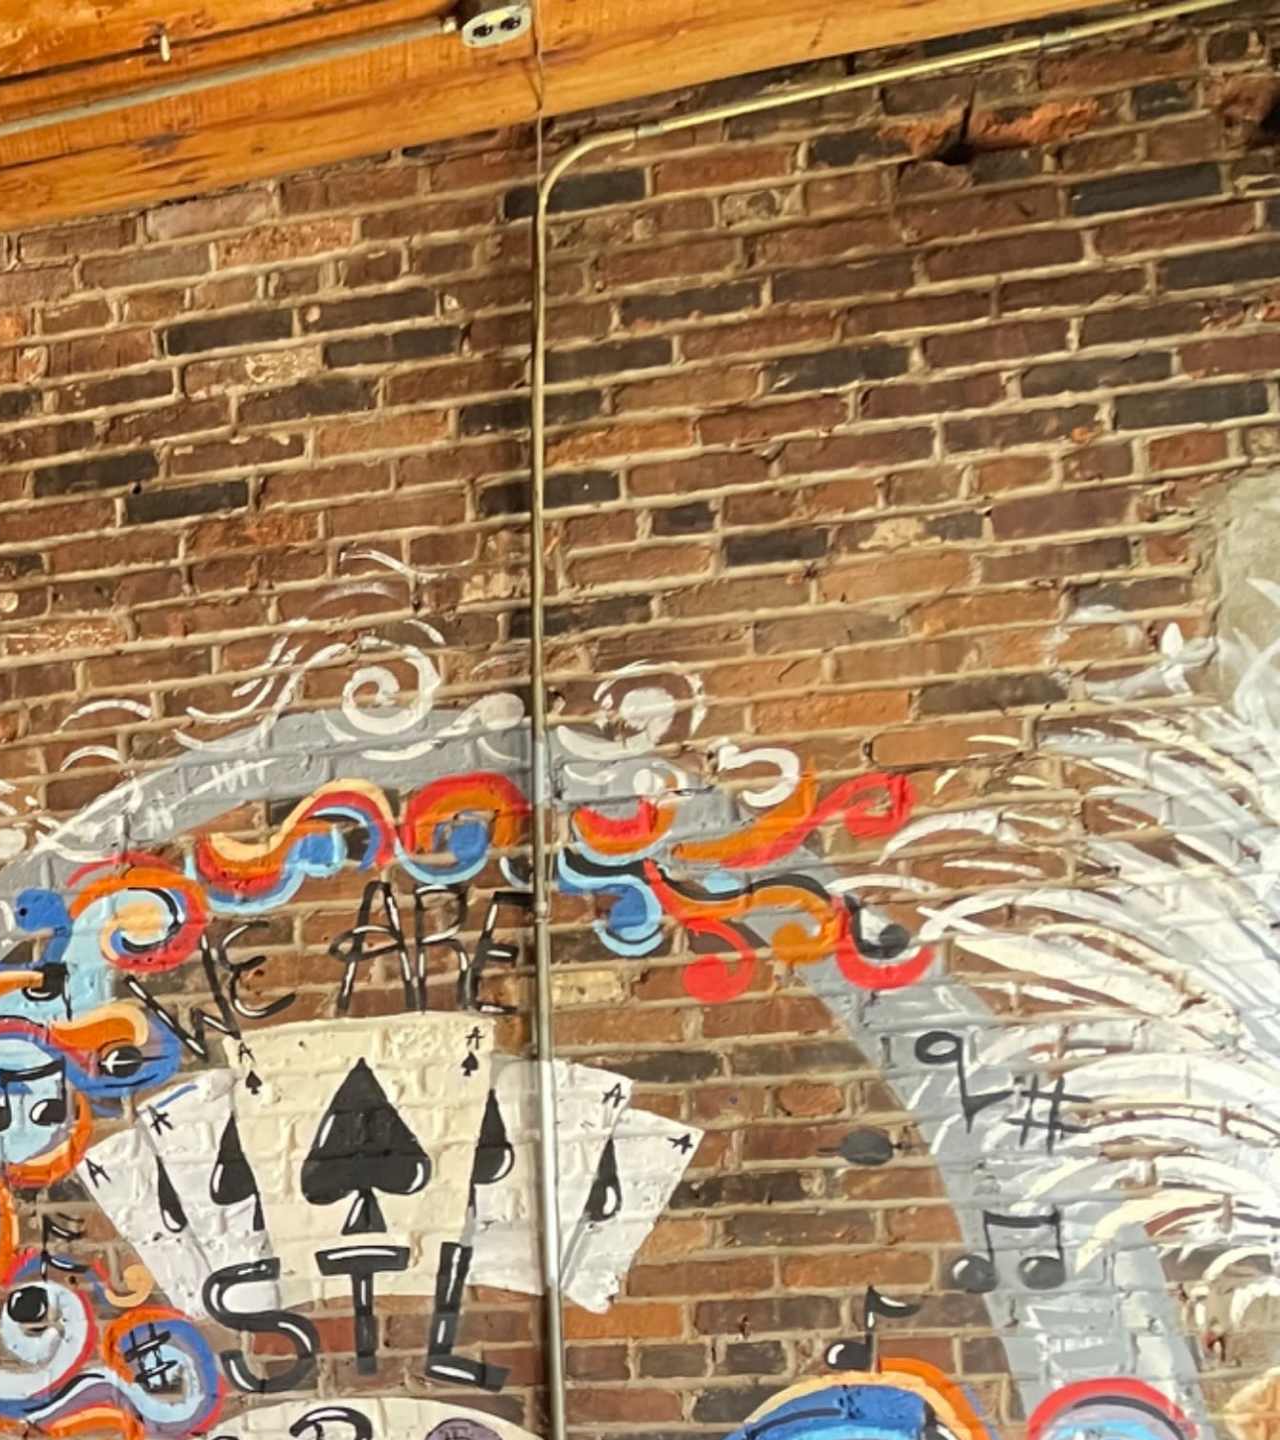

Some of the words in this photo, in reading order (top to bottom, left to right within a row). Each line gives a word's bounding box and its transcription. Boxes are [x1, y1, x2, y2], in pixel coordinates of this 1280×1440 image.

[127, 919, 297, 1060] WE
[330, 880, 536, 1014] ARE
[202, 1241, 511, 1393] STL
